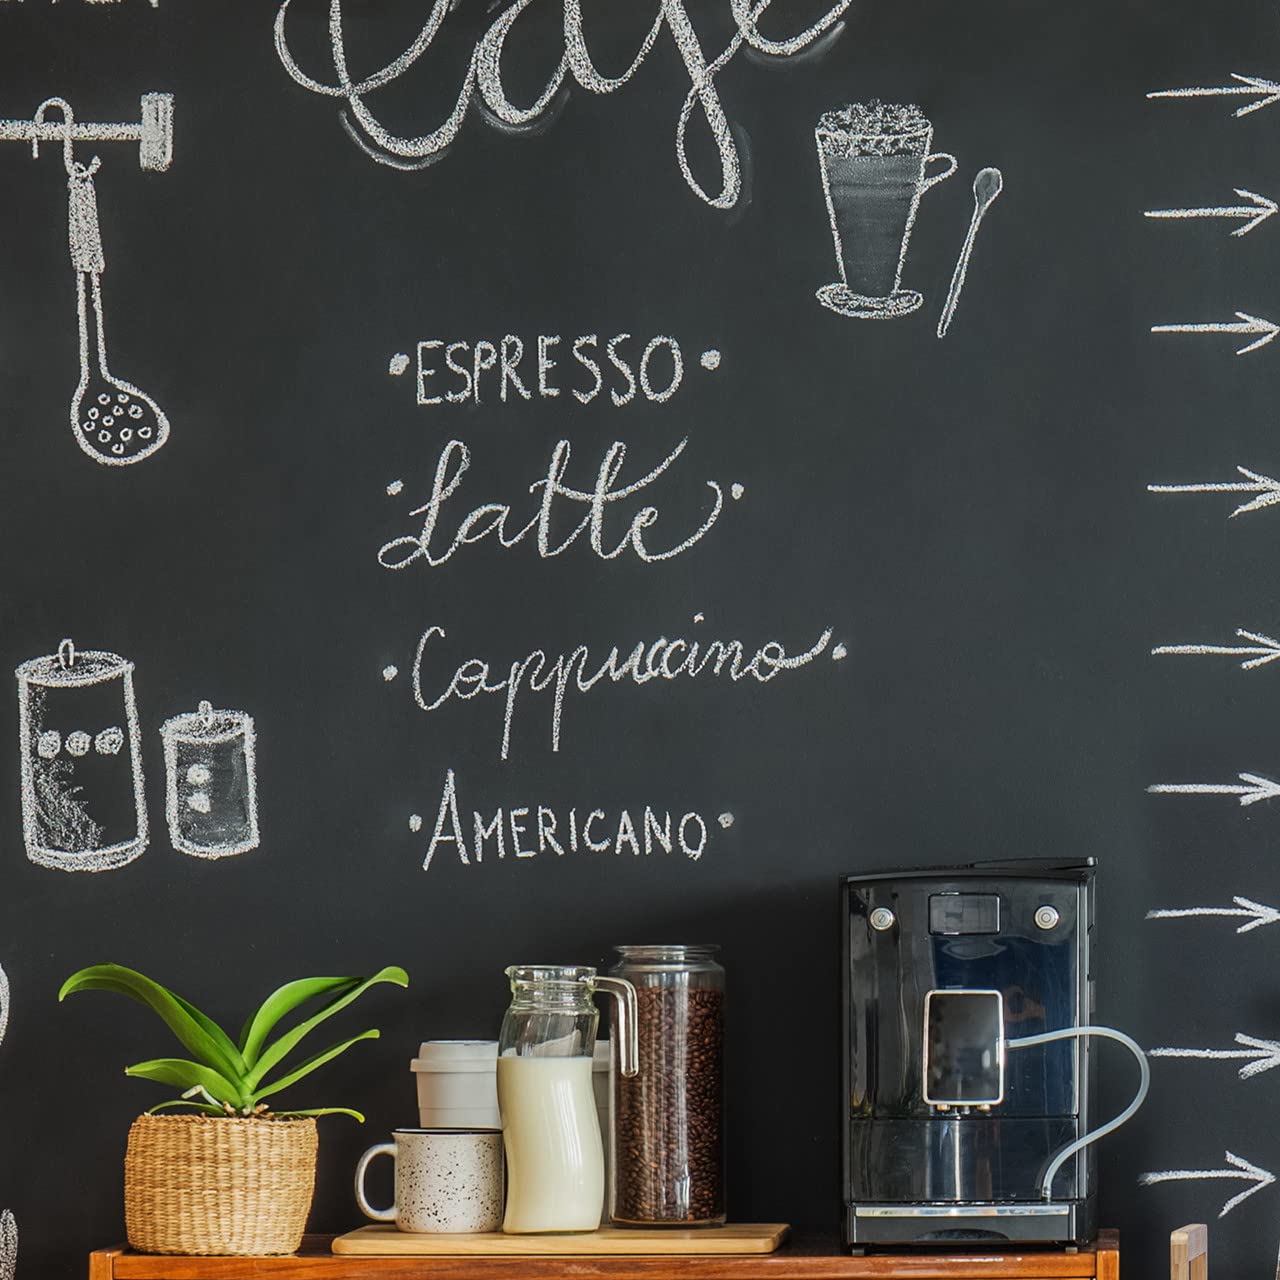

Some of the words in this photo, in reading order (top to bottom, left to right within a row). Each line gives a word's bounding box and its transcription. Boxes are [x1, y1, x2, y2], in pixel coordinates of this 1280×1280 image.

[416, 334, 684, 405] ESPRESSO
[378, 434, 724, 569] Latte
[421, 769, 708, 872] AMERICANO
